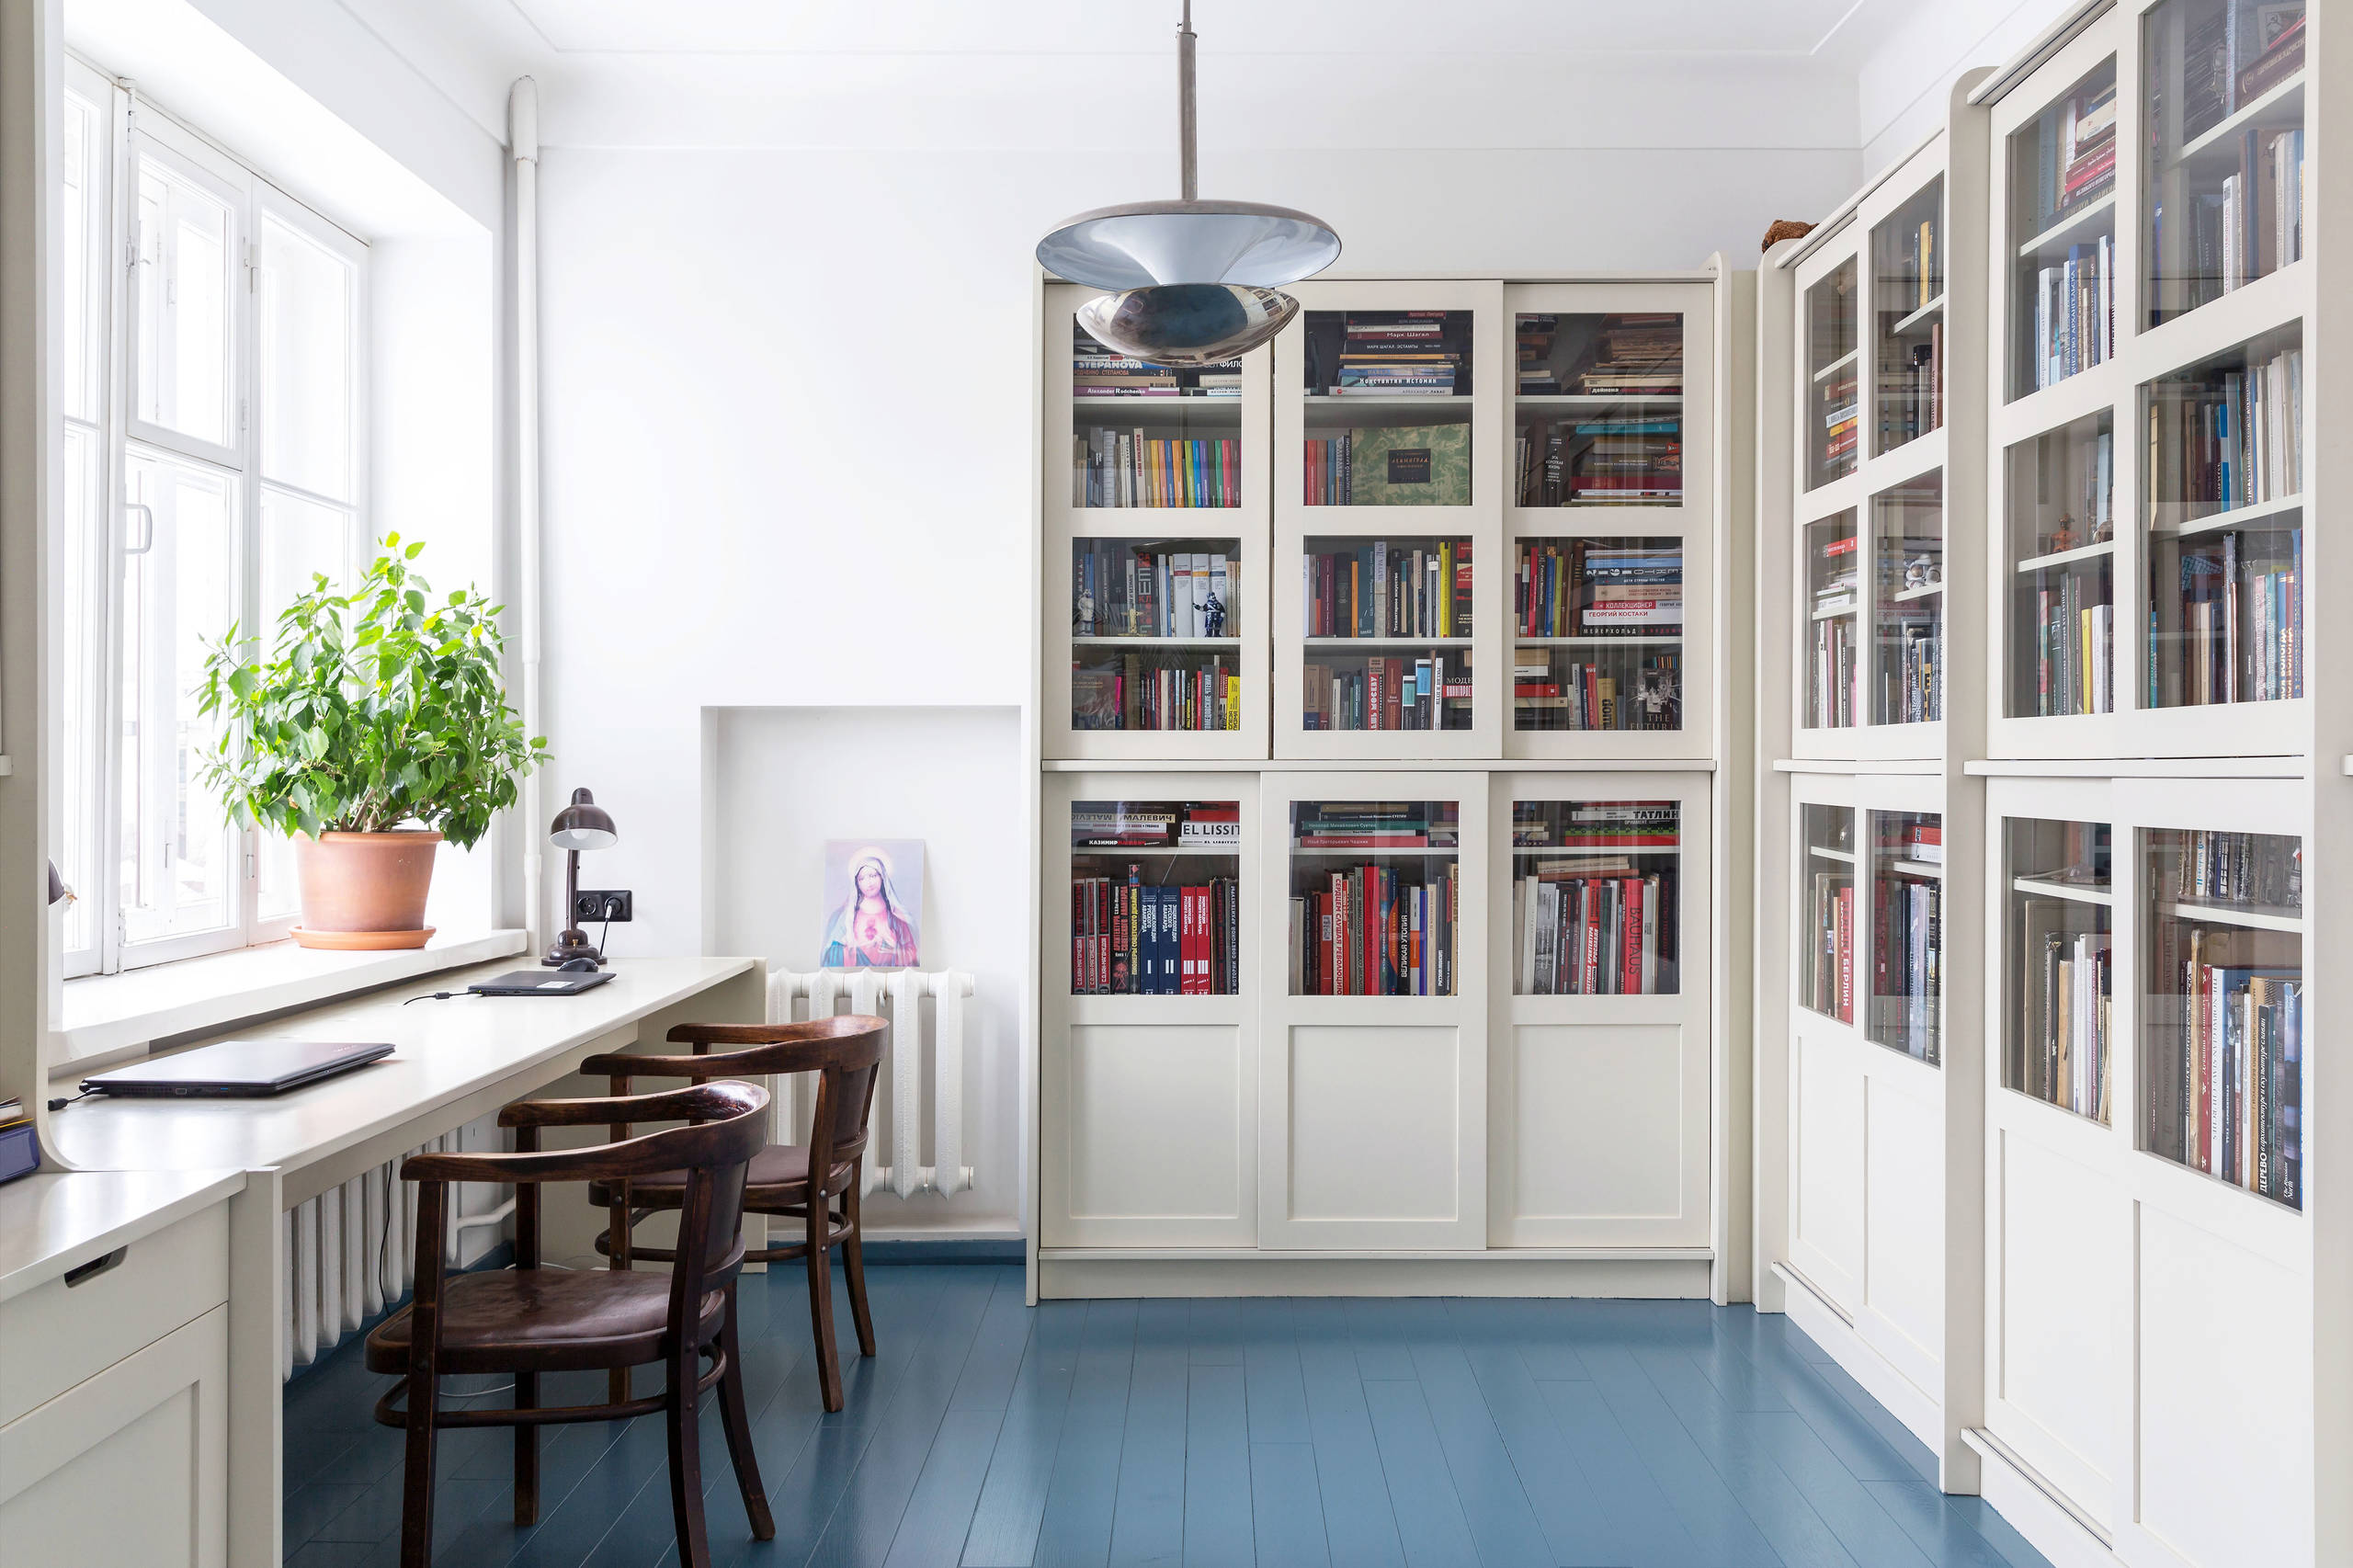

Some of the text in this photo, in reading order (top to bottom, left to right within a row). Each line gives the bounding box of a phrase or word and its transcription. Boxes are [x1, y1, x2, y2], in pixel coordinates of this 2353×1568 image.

[1078, 360, 1142, 369] STEPANOVA
[1370, 676, 1378, 710] МОСКВУ
[1633, 811, 1680, 819] ТАТЛИН
[1183, 824, 1199, 835] EL
[1629, 906, 1642, 976] BAUHAUS
[1183, 960, 1194, 974] III
[1198, 960, 1209, 974] III
[2259, 1047, 2268, 1088] скульптуре
[2259, 1096, 2268, 1147] архитектуре
[2259, 1152, 2268, 1193] ДЕРЕВО
[2287, 1180, 2295, 1200] North
